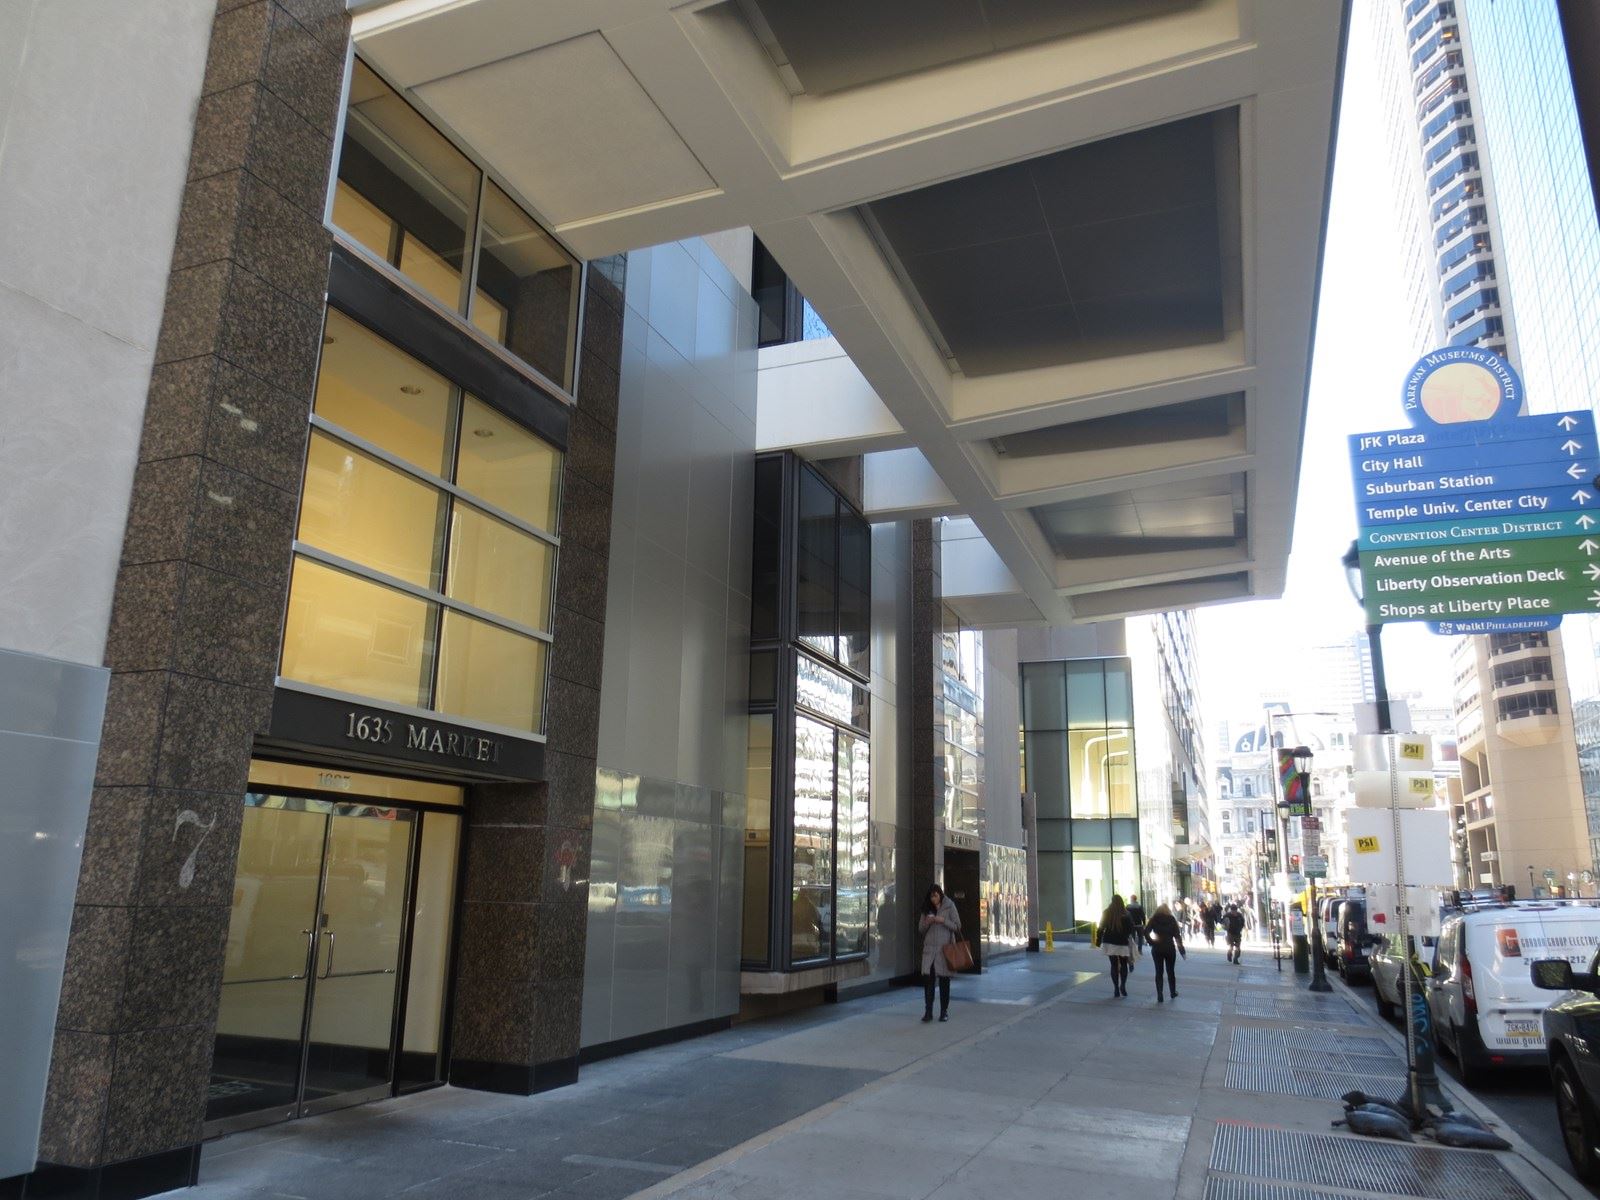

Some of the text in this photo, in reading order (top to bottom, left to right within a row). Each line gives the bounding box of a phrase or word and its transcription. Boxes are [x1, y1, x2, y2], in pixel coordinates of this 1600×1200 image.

[1406, 351, 1515, 410] PARKWAY MUSEUMS DISTRICT
[1360, 434, 1425, 451] JFK Plaza
[1362, 456, 1423, 473] City Hall
[1366, 474, 1494, 495] Suburban Station
[1366, 495, 1548, 520] Temple Univ. Center City
[1369, 521, 1562, 544] CONVENTION CENTER DISTRICT
[1374, 547, 1511, 567] Avenue of the Arts
[1376, 568, 1565, 592] Liberty Observation Deck
[1380, 596, 1550, 618] Shops at Liberty Place
[346, 712, 505, 763] 1635 MARKET
